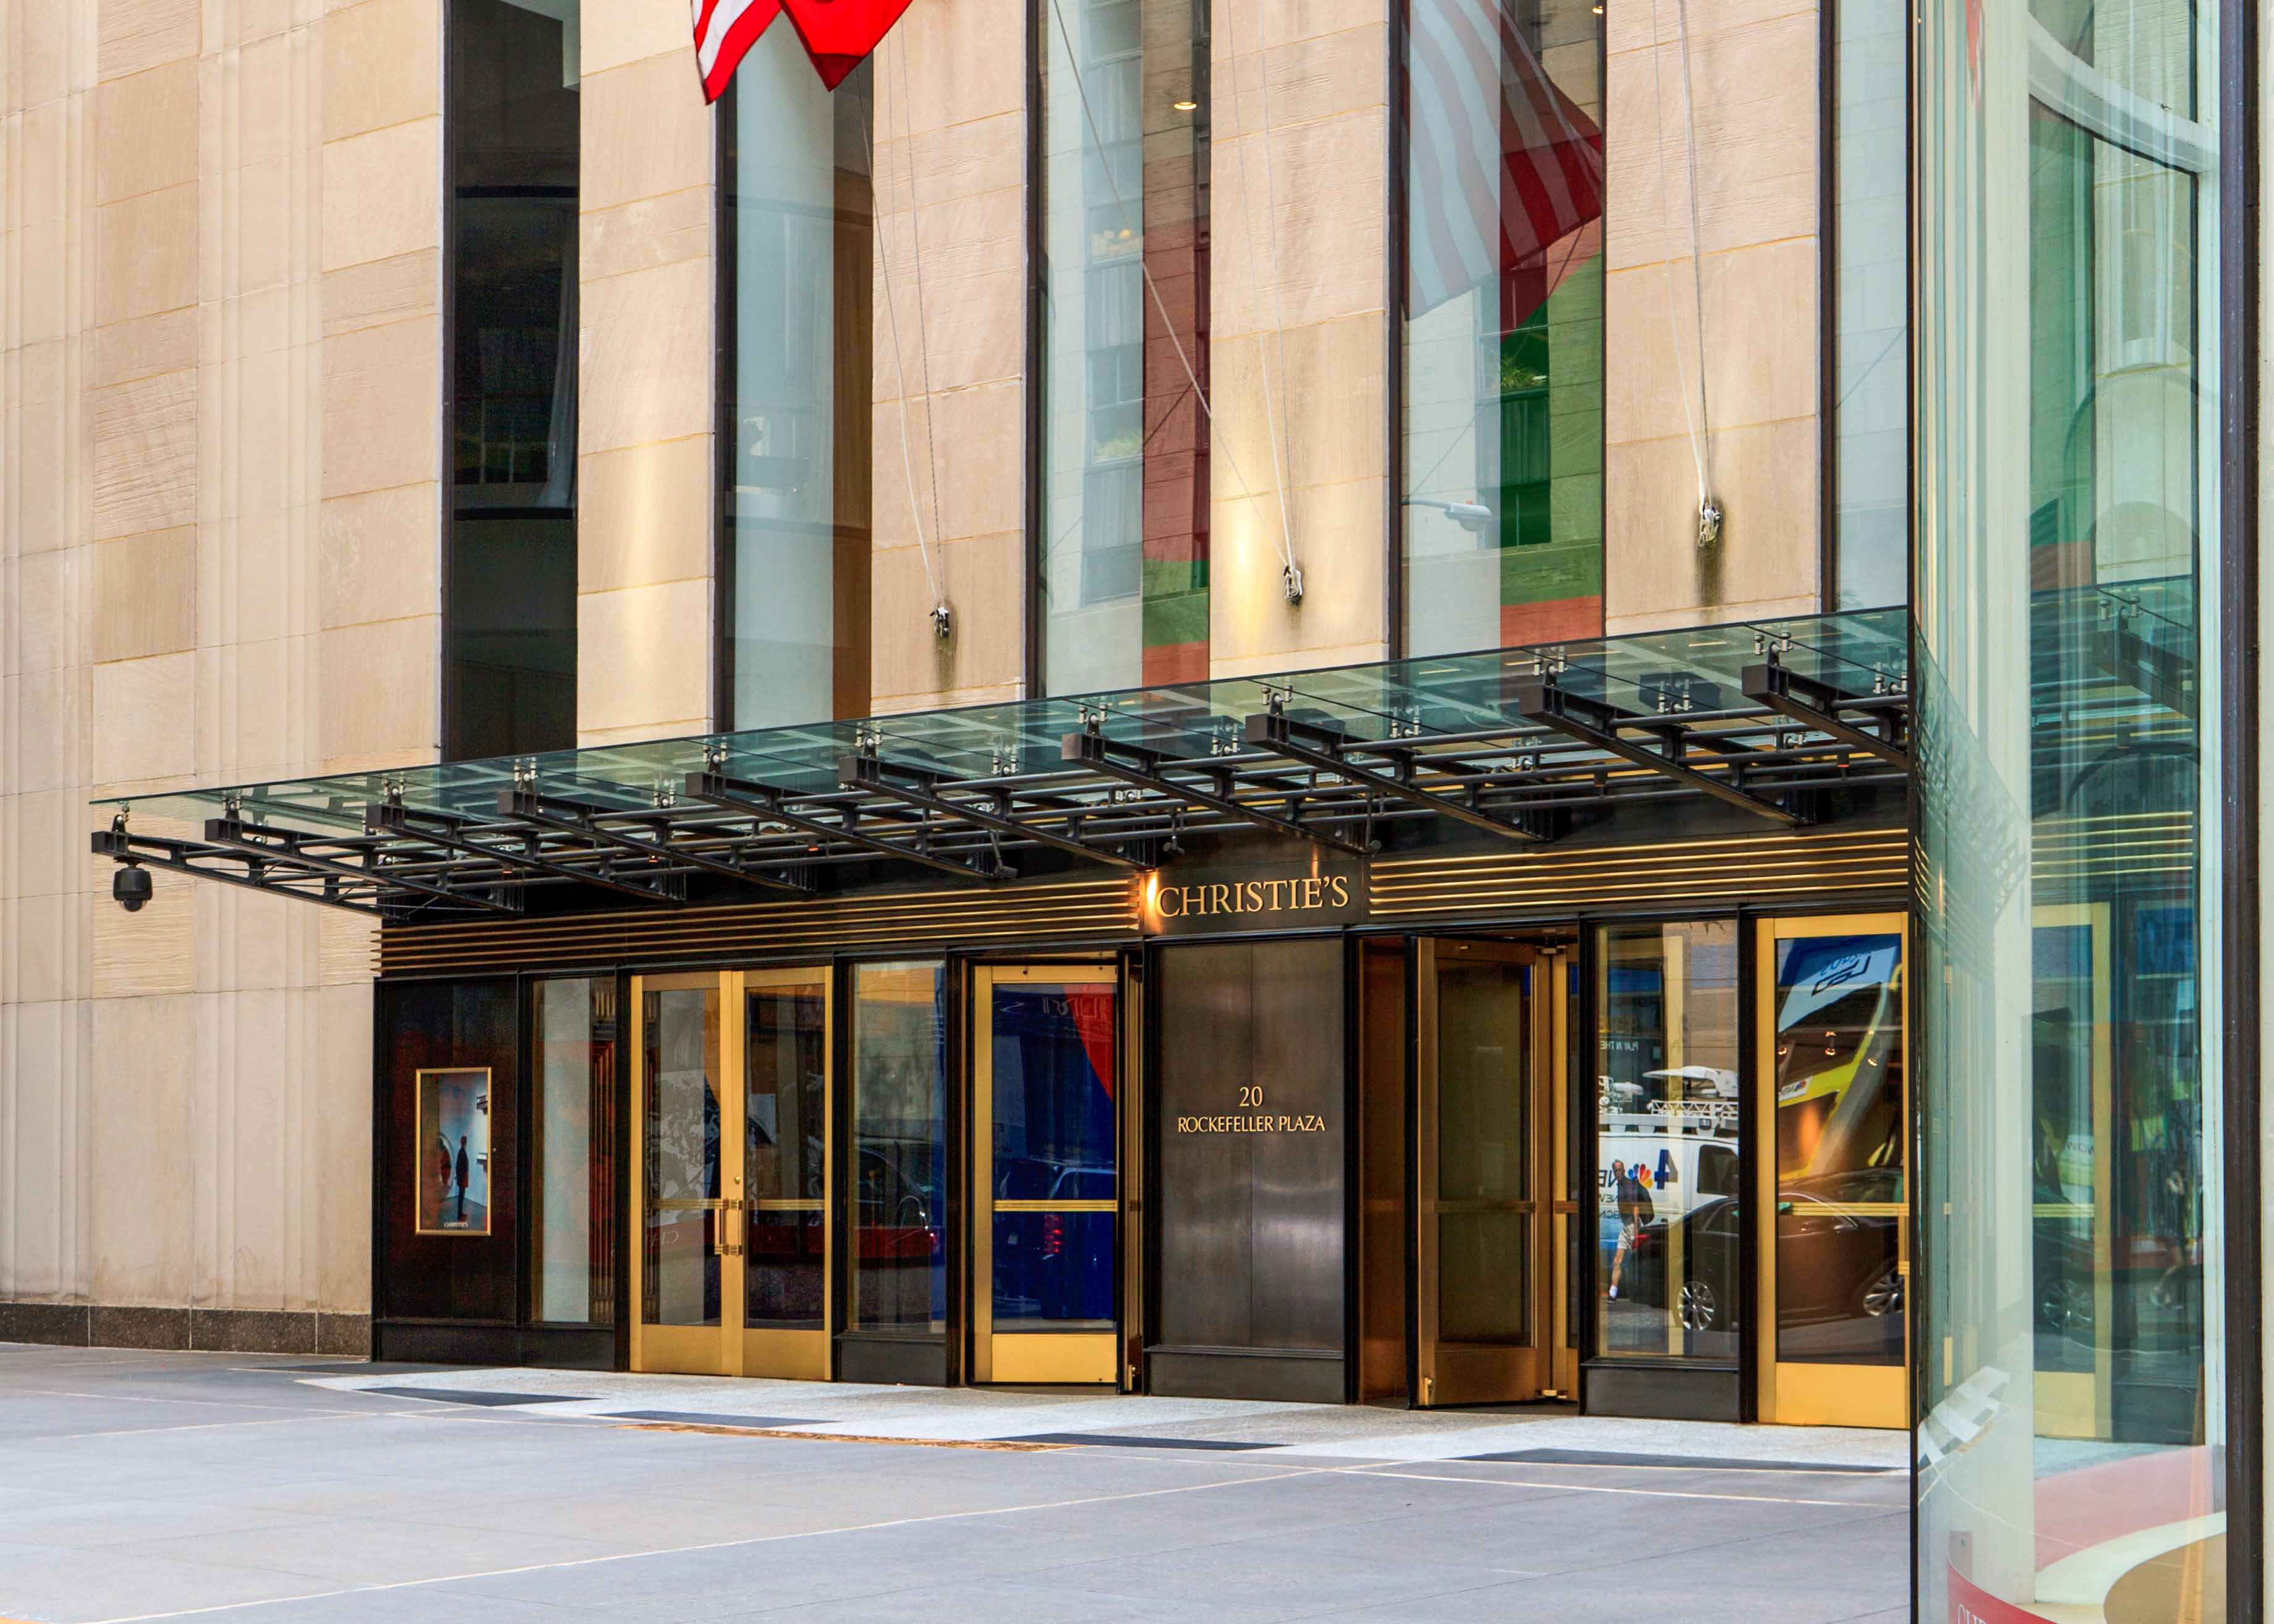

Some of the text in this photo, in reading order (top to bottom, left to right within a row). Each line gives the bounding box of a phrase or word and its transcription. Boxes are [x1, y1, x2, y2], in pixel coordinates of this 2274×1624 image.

[1156, 875, 1349, 917] CHRISTIE'S
[1239, 1086, 1263, 1107] 20
[1178, 1115, 1326, 1133] ROCKEFELLER PLAZA
